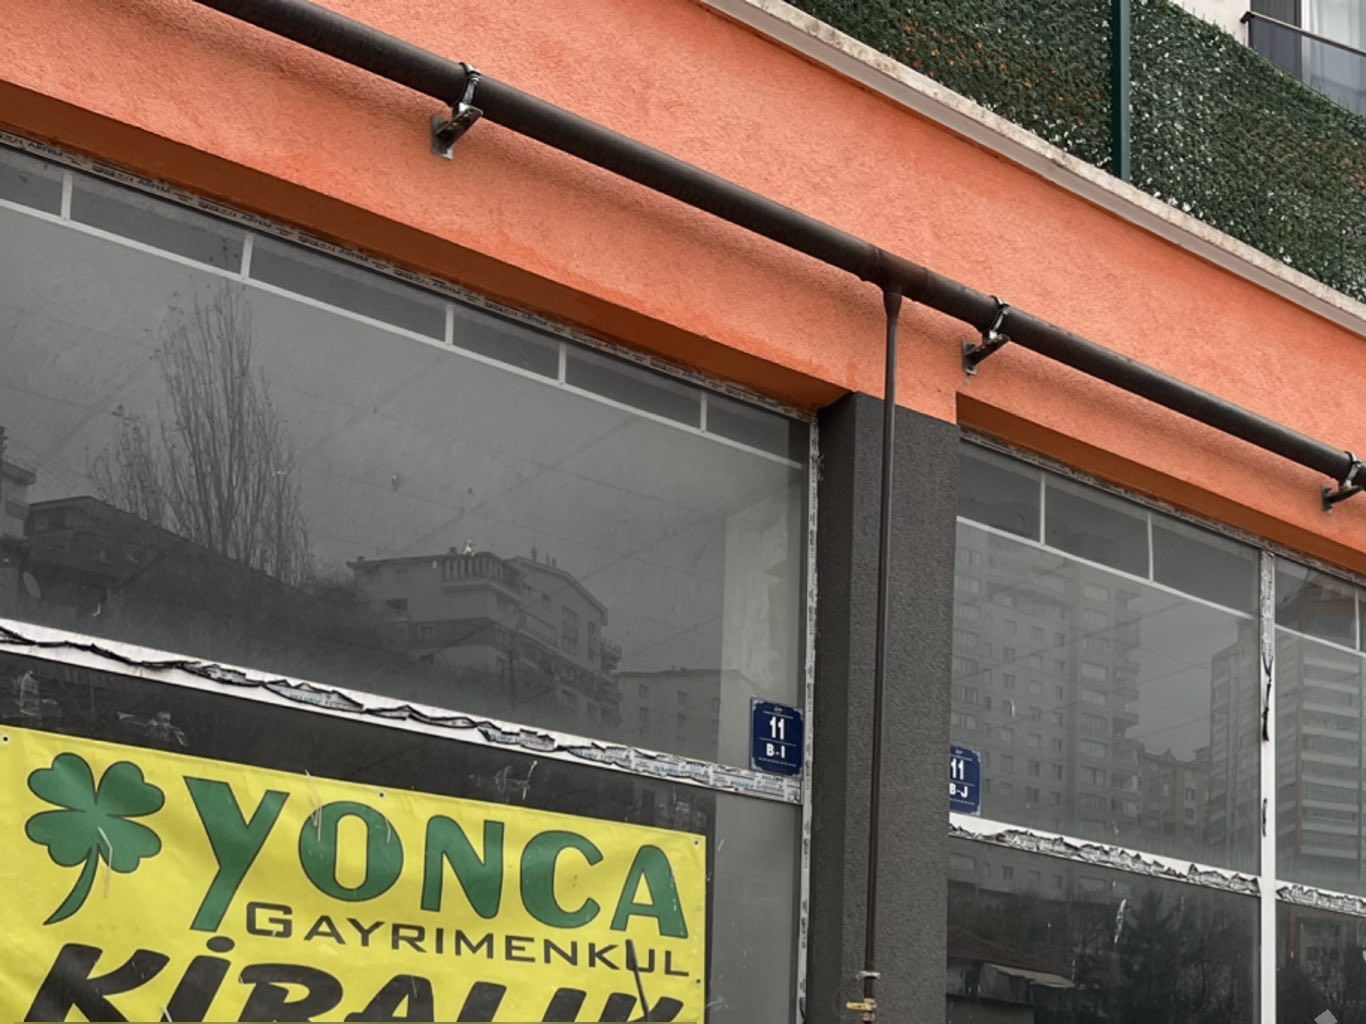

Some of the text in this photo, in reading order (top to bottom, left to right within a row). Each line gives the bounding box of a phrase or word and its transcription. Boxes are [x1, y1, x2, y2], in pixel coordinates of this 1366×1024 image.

[769, 716, 785, 740] 11
[950, 758, 964, 780] 11
[183, 776, 689, 938] YONCA
[246, 902, 689, 977] GAYRIMENKUL
